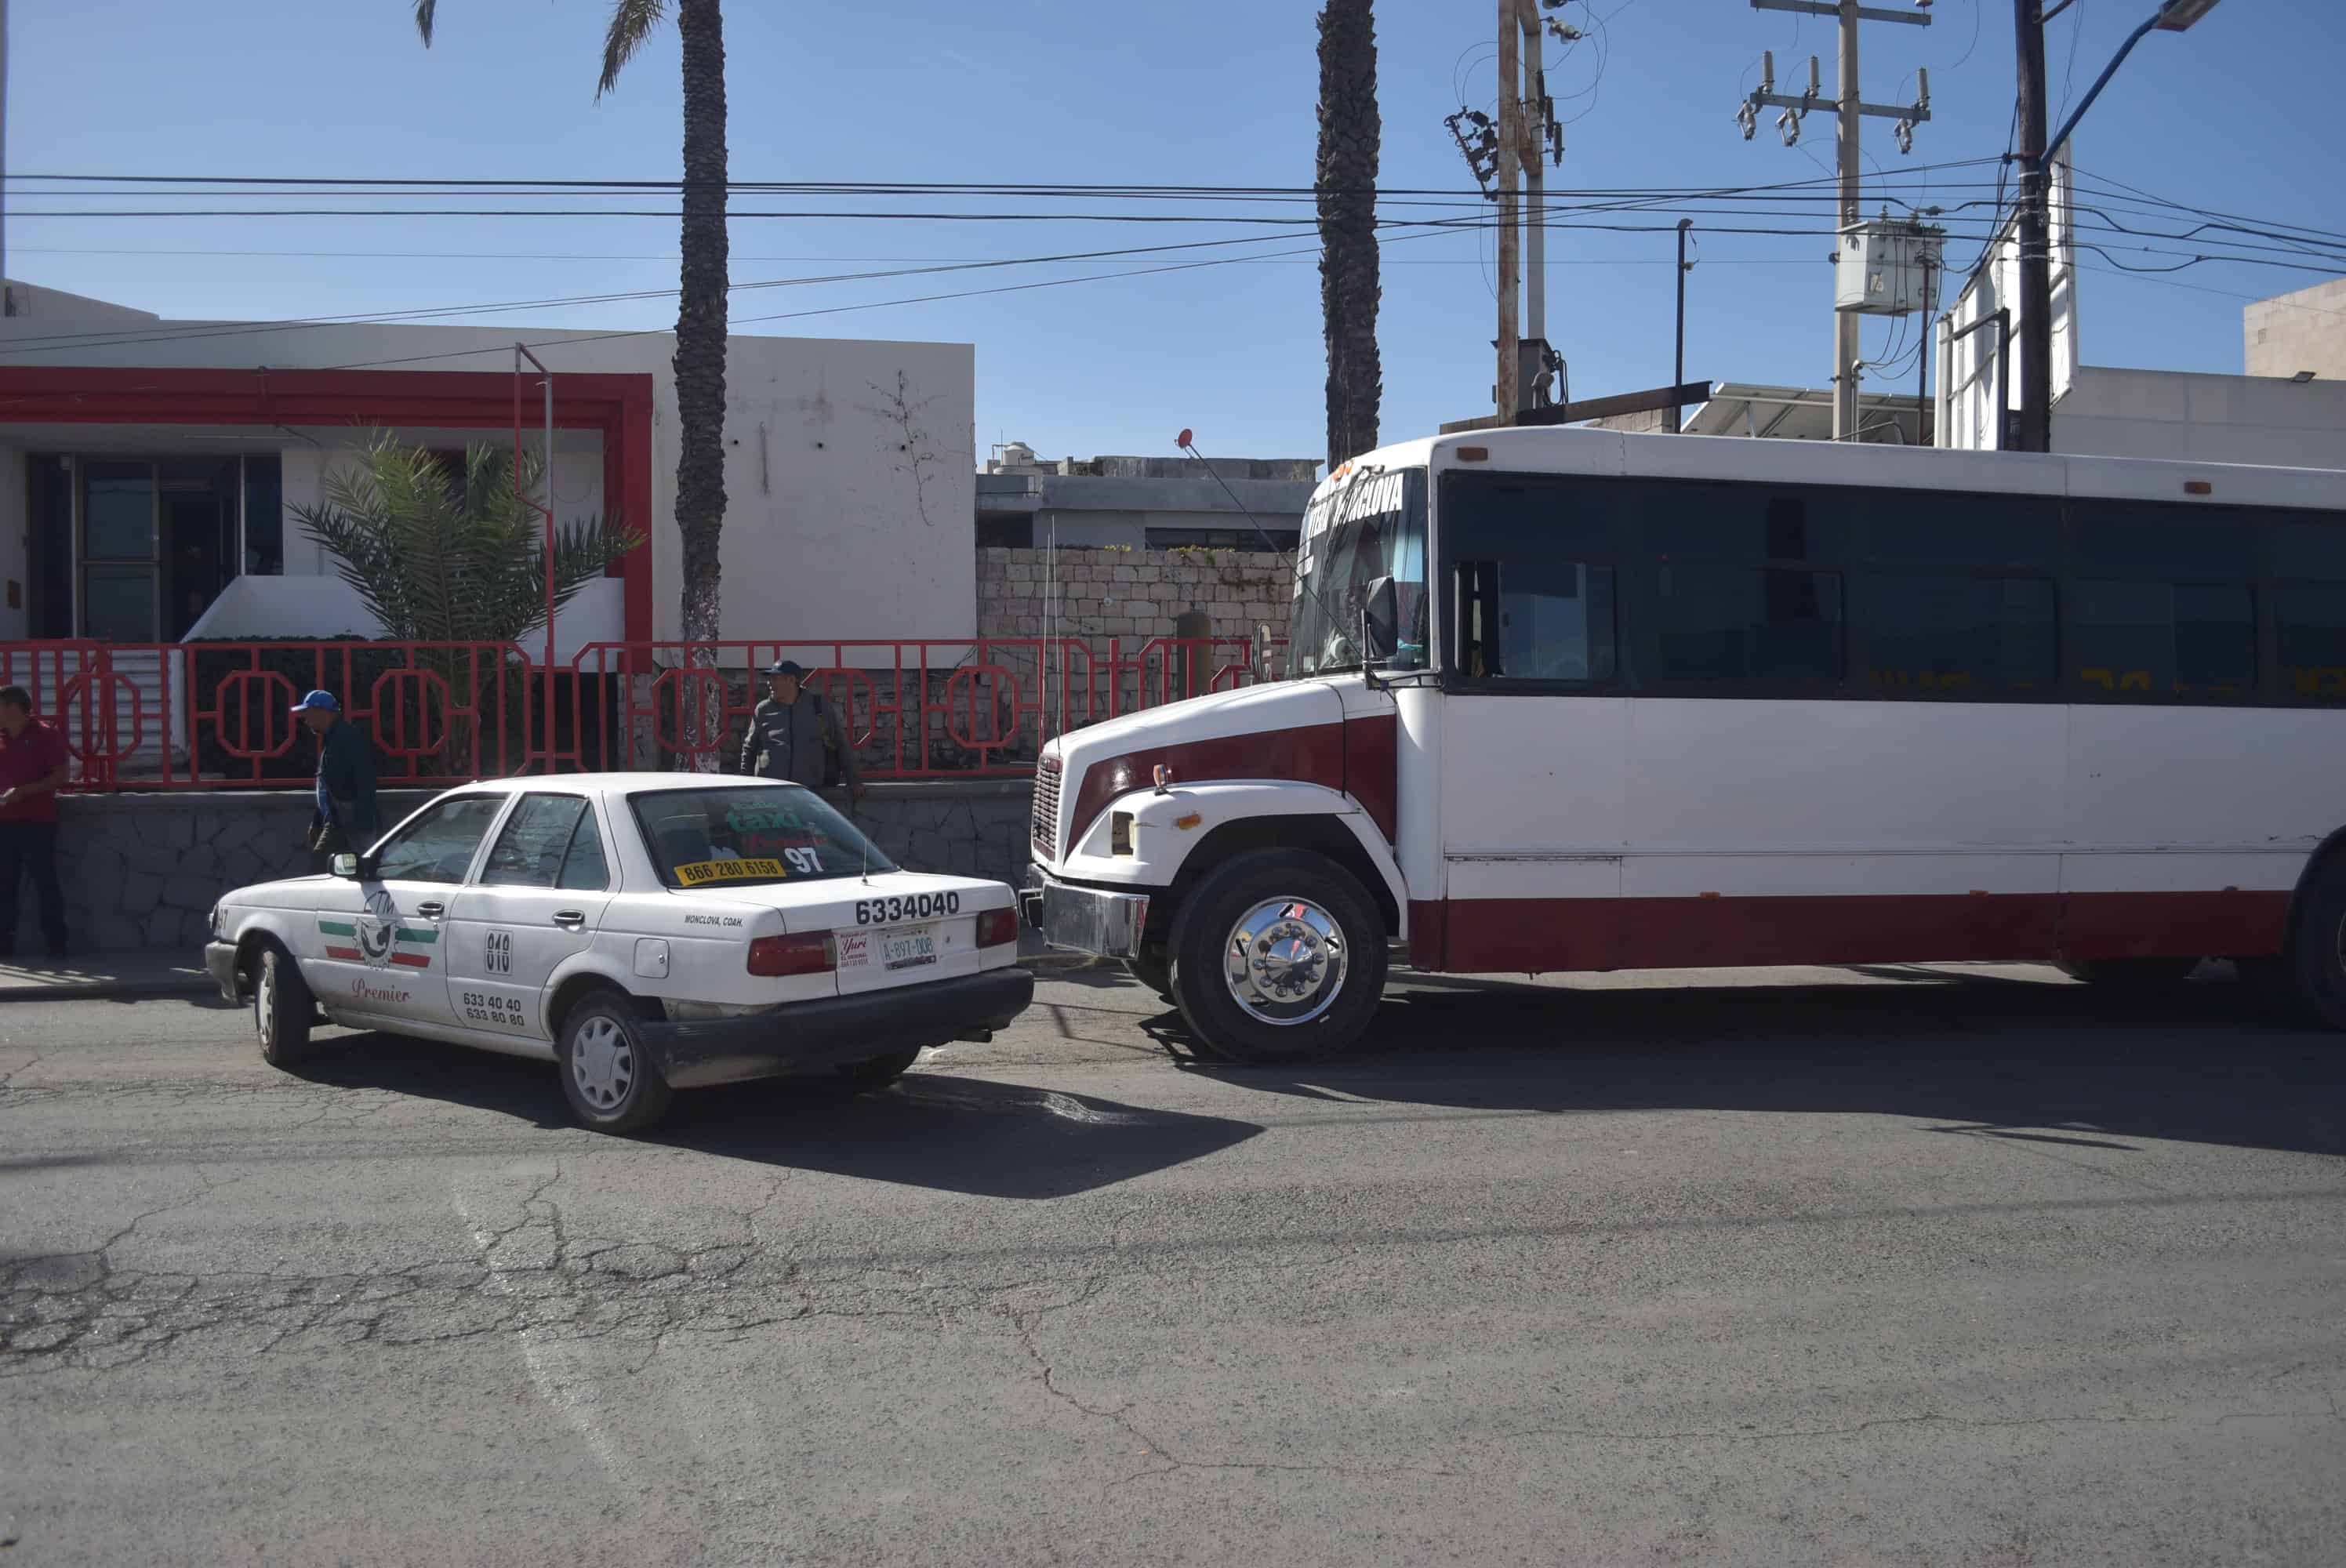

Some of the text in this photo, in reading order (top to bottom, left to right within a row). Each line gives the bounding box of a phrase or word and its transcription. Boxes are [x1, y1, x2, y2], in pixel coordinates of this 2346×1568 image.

[685, 860, 778, 880] 866 280 6158
[784, 847, 824, 873] 97
[855, 891, 960, 925] 6334040
[685, 915, 743, 927] MONCLOVA, COAH.
[352, 978, 412, 1003] Premier
[463, 992, 521, 1012] 633 40 40
[466, 1007, 525, 1026] 633 80 80
